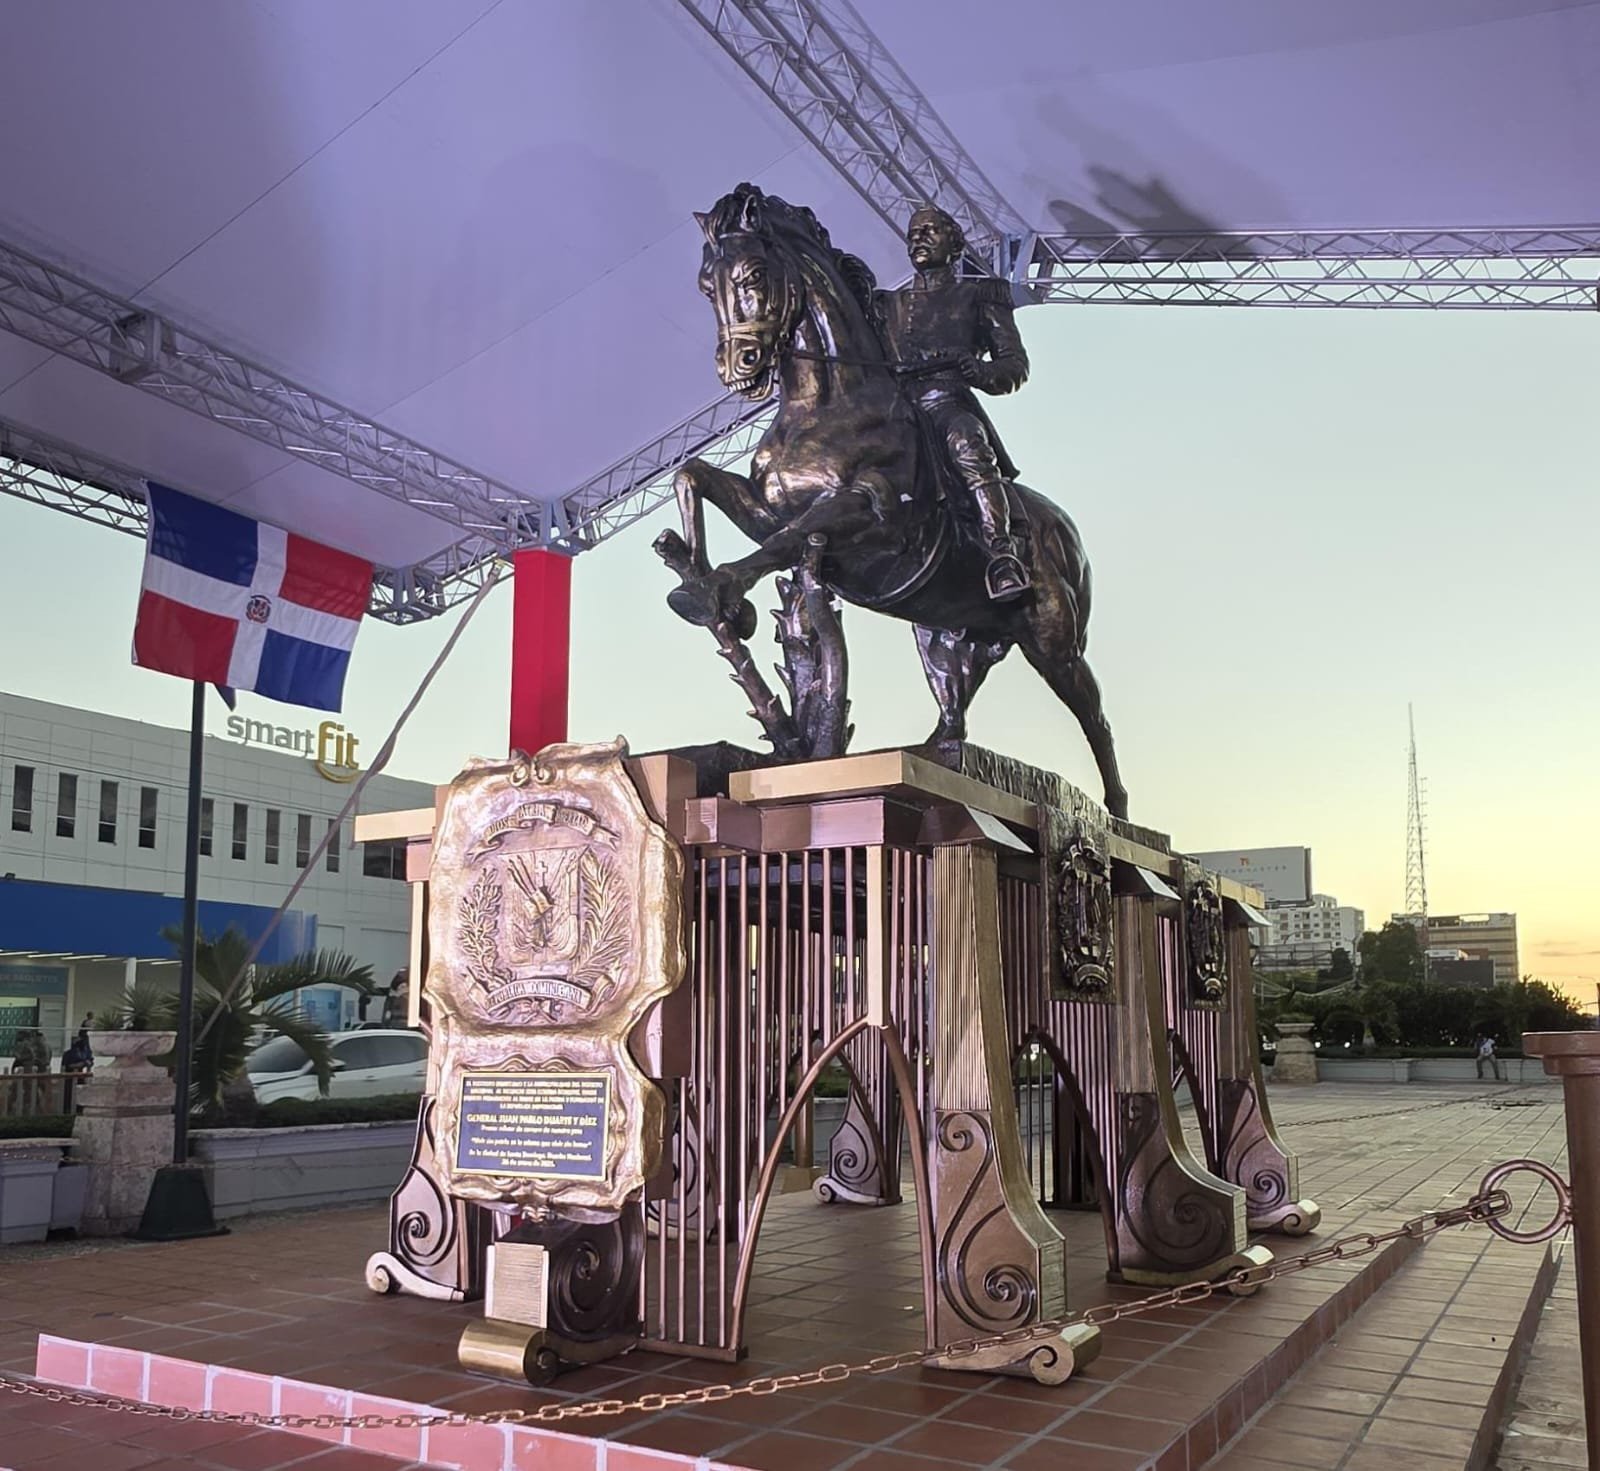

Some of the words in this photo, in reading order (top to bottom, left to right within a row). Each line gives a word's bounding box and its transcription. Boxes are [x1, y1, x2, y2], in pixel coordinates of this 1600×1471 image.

[227, 715, 315, 754] smart
[318, 721, 360, 769] fit
[466, 1113, 497, 1123] GENERAL
[498, 1114, 519, 1124] JUAN
[519, 1114, 543, 1125] PABLO
